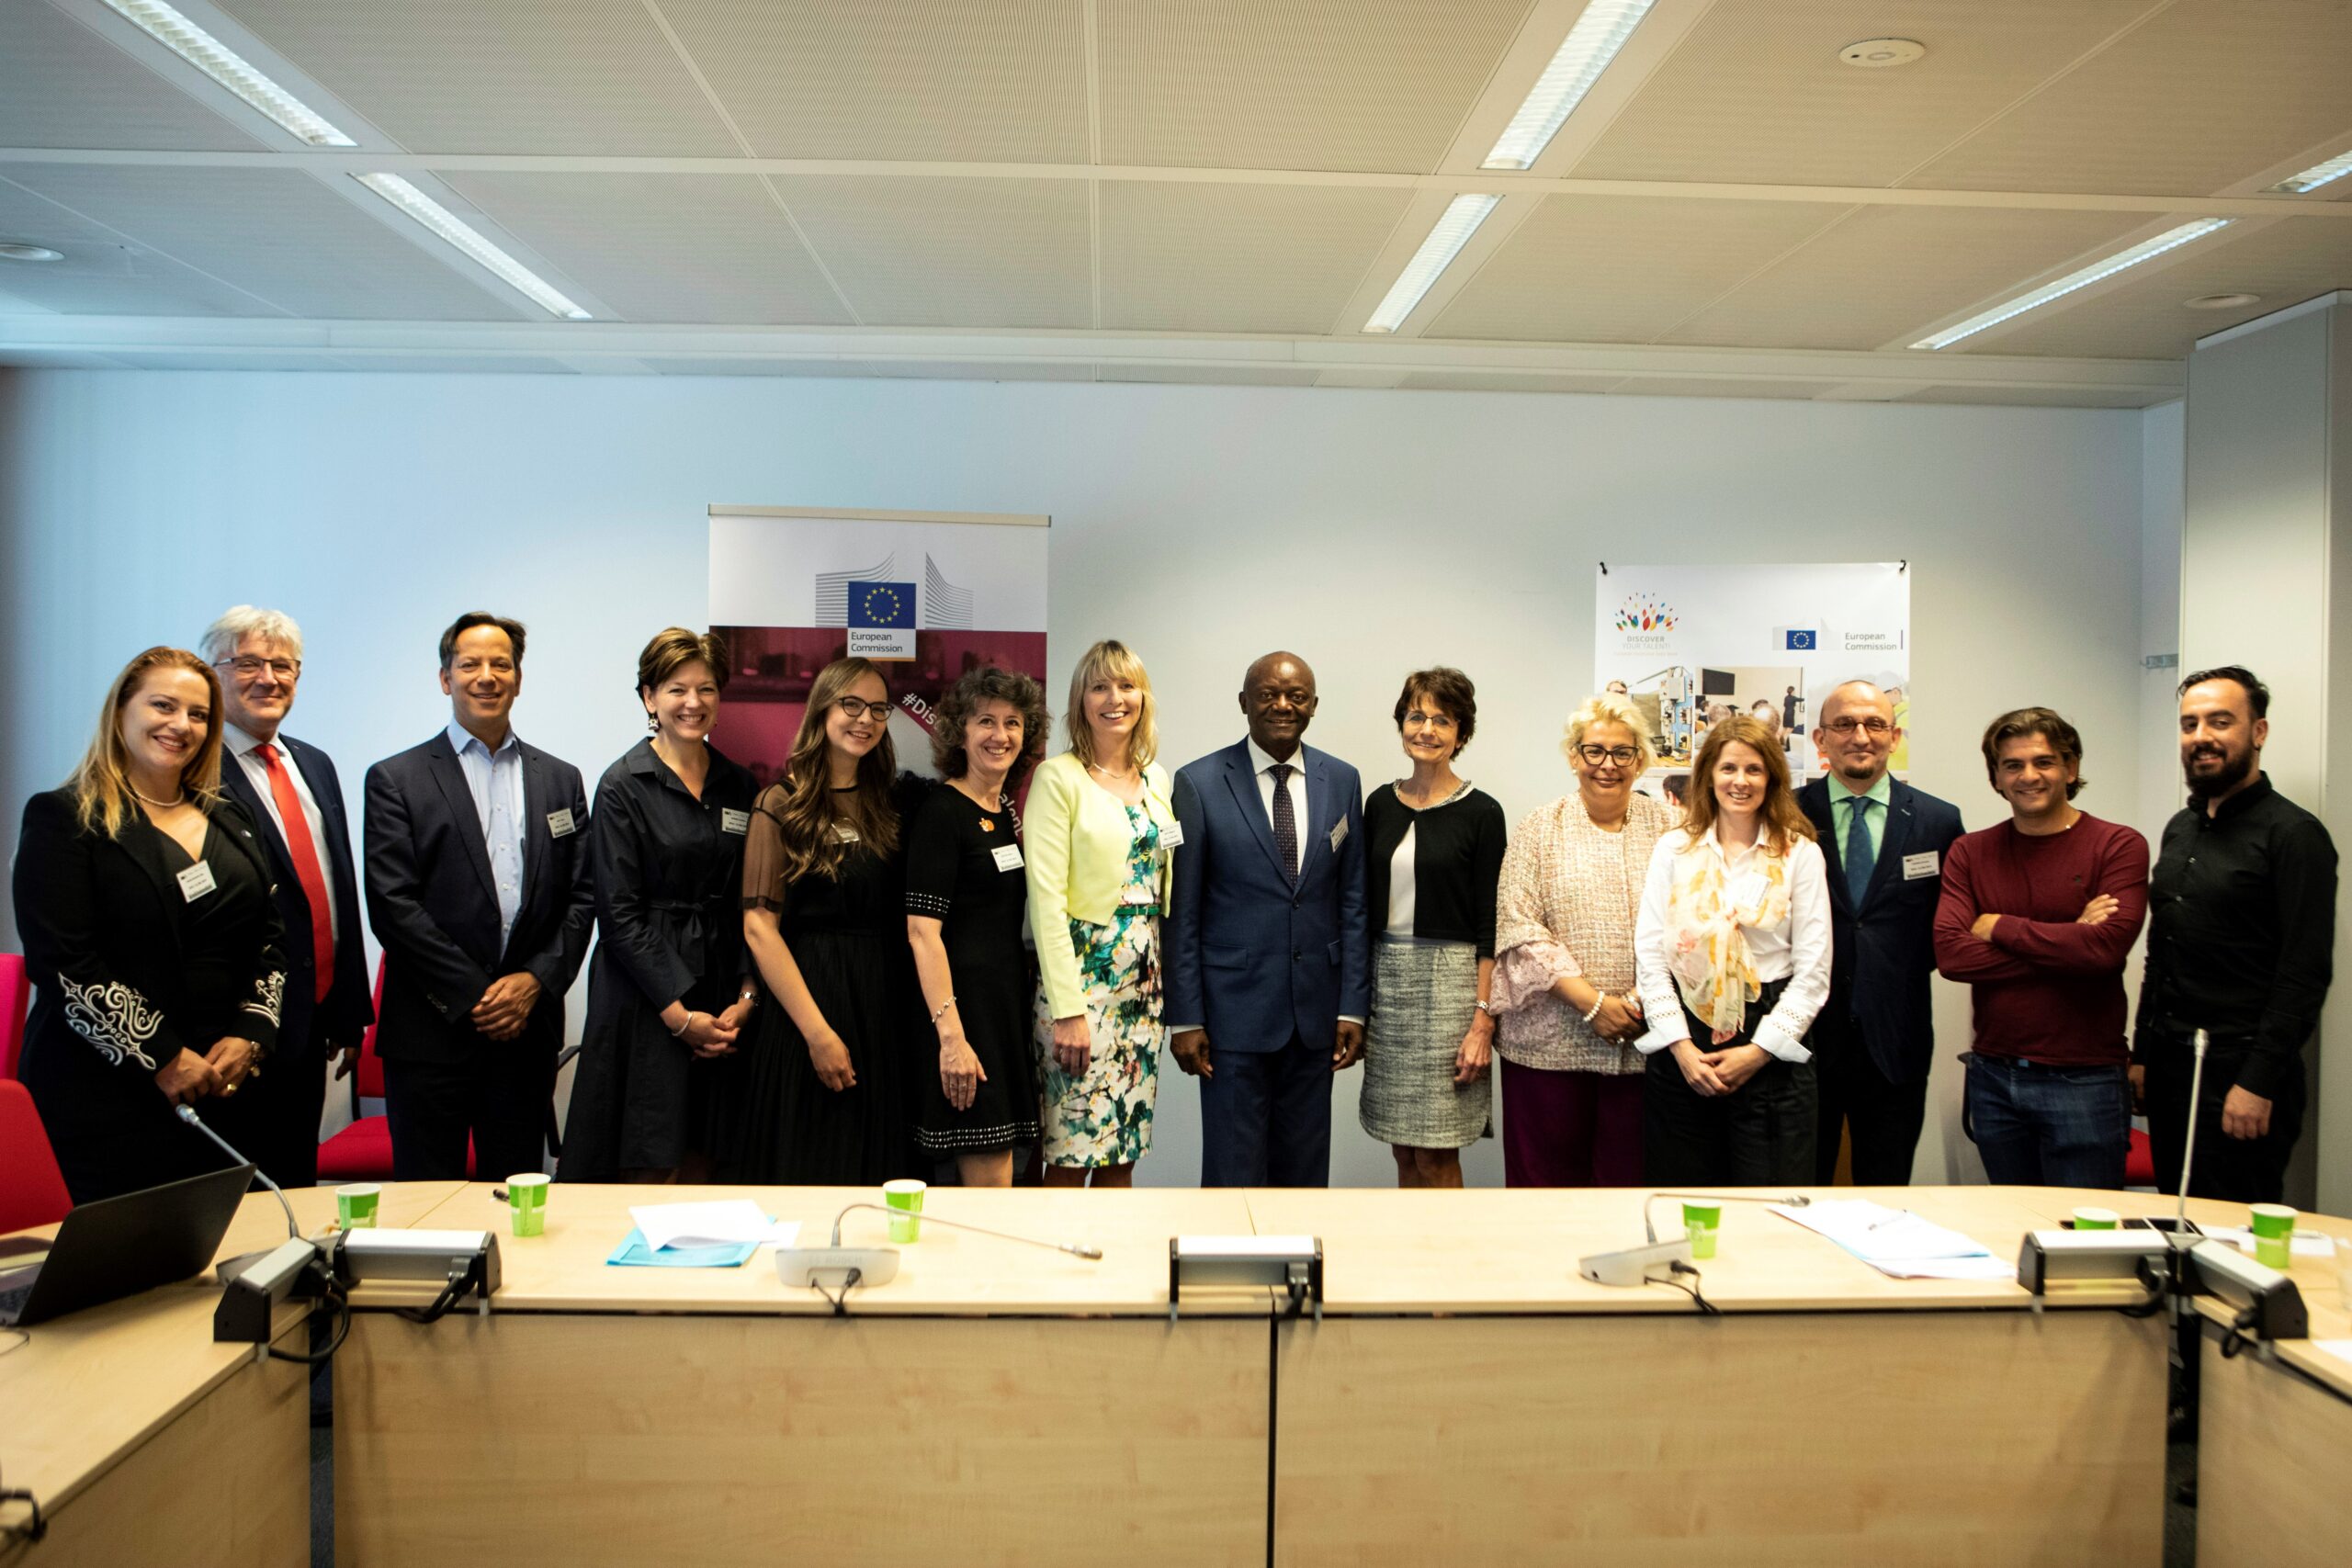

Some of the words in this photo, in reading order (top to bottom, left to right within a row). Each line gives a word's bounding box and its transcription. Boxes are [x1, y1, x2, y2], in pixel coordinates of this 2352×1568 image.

[852, 632, 892, 642] European
[1845, 632, 1886, 641] European
[852, 644, 903, 653] Commission
